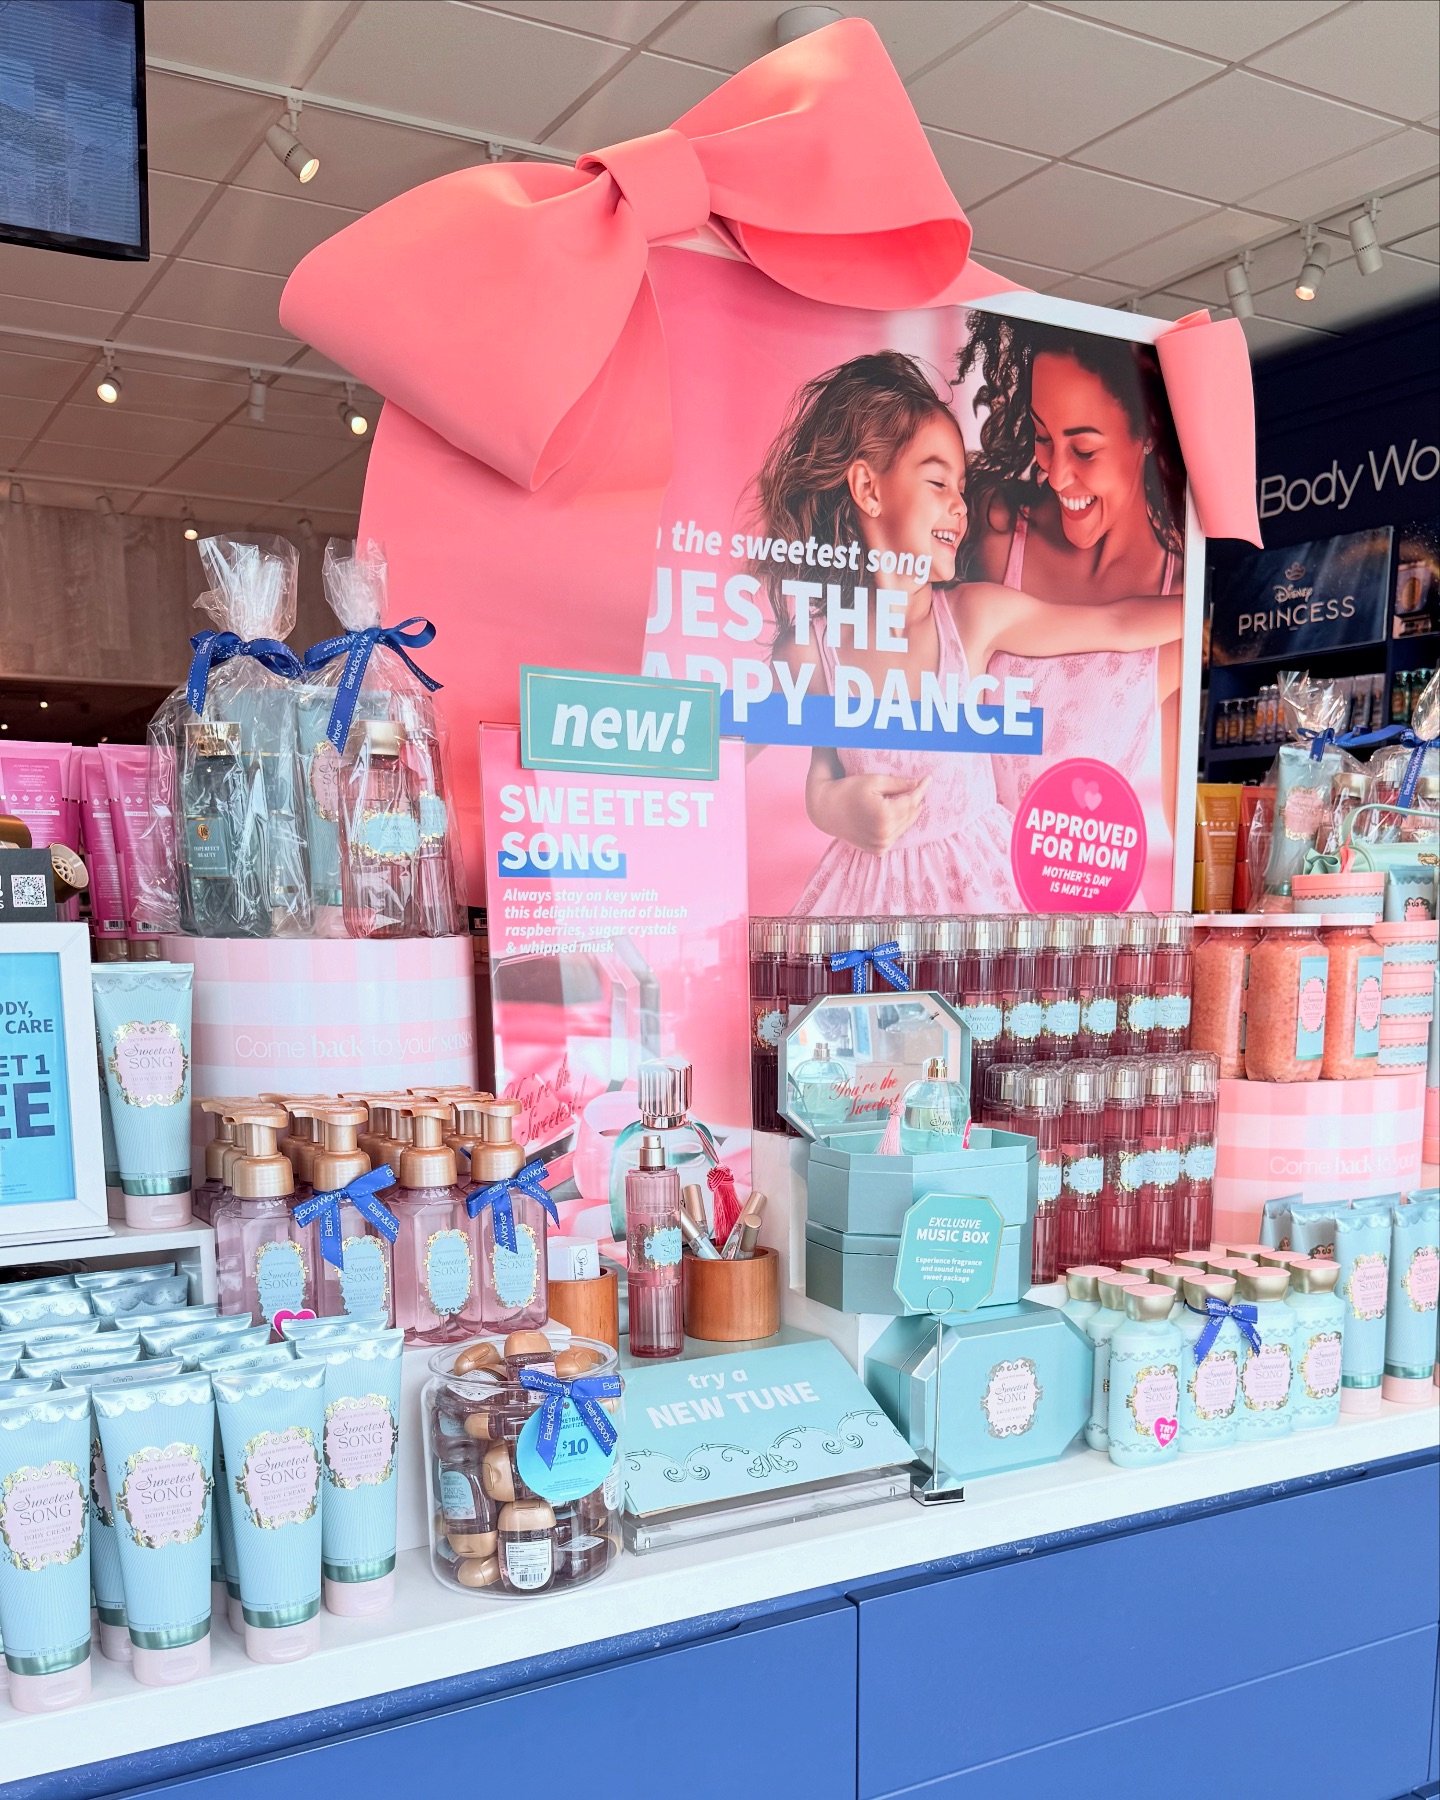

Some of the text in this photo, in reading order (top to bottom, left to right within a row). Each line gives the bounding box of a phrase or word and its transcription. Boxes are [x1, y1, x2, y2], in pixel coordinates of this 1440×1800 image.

[1259, 459, 1364, 519] Body
[672, 520, 932, 585] the sweetest song
[1273, 584, 1313, 603] Disney
[781, 579, 909, 653] THE
[1238, 595, 1356, 636] PRINCESS
[834, 665, 1034, 737] DANCE
[551, 701, 692, 755] new!
[499, 784, 714, 828] SWEETEST
[1025, 807, 1138, 849] APPROVED
[501, 831, 620, 872] SONG
[1030, 833, 1128, 872] FOR MOM
[1042, 865, 1112, 888] MOTHER'S DAY
[503, 888, 659, 904] Always stay on key with
[1049, 881, 1060, 893] IS
[1061, 883, 1082, 897] MAY
[504, 906, 688, 924] this delightful blend of blush
[505, 923, 677, 939] raspberries, sugar crystals
[505, 940, 614, 956] & whipped musk
[5, 1019, 54, 1034] CARE
[124, 1044, 176, 1057] Sweetest
[235, 1035, 305, 1058] Come
[312, 1034, 364, 1058] back
[369, 1036, 392, 1056] to
[396, 1036, 437, 1060] your
[35, 1054, 50, 1075] 1
[129, 1057, 173, 1069] SONG
[880, 1068, 898, 1091] the
[1145, 1167, 1176, 1176] SONG
[1270, 1156, 1331, 1175] Come
[1335, 1155, 1374, 1174] back
[929, 1217, 982, 1229] EXCLUSIVE
[916, 1228, 990, 1244] MUSIC BOX
[344, 1264, 382, 1275] Sweetest
[500, 1259, 530, 1269] SONG
[916, 1257, 982, 1266] Experience fragrance
[261, 1269, 301, 1281] Sweetest
[346, 1272, 379, 1283] SONG
[434, 1265, 464, 1277] SONG
[943, 1274, 970, 1283] package
[265, 1279, 298, 1289] SONG
[1360, 1280, 1384, 1292] SONG
[688, 1368, 748, 1391] try a
[1206, 1378, 1231, 1388] SONG
[1255, 1370, 1283, 1380] SONG
[645, 1381, 821, 1429] NEW TUNE
[997, 1391, 1026, 1405] SONG
[1145, 1392, 1171, 1402] SONG
[333, 1420, 386, 1436] Sweetest
[1160, 1424, 1176, 1434] TRY
[338, 1431, 383, 1449] SONG
[562, 1438, 589, 1457] $10
[254, 1454, 309, 1474] Sweetest
[135, 1472, 196, 1491] Sweetest
[260, 1466, 307, 1487] SONG
[13, 1490, 74, 1511] Sweetest
[141, 1484, 192, 1505] SONG
[19, 1503, 71, 1526] SONG
[166, 1507, 192, 1516] CREAM
[24, 1526, 71, 1541] BODY CREAM
